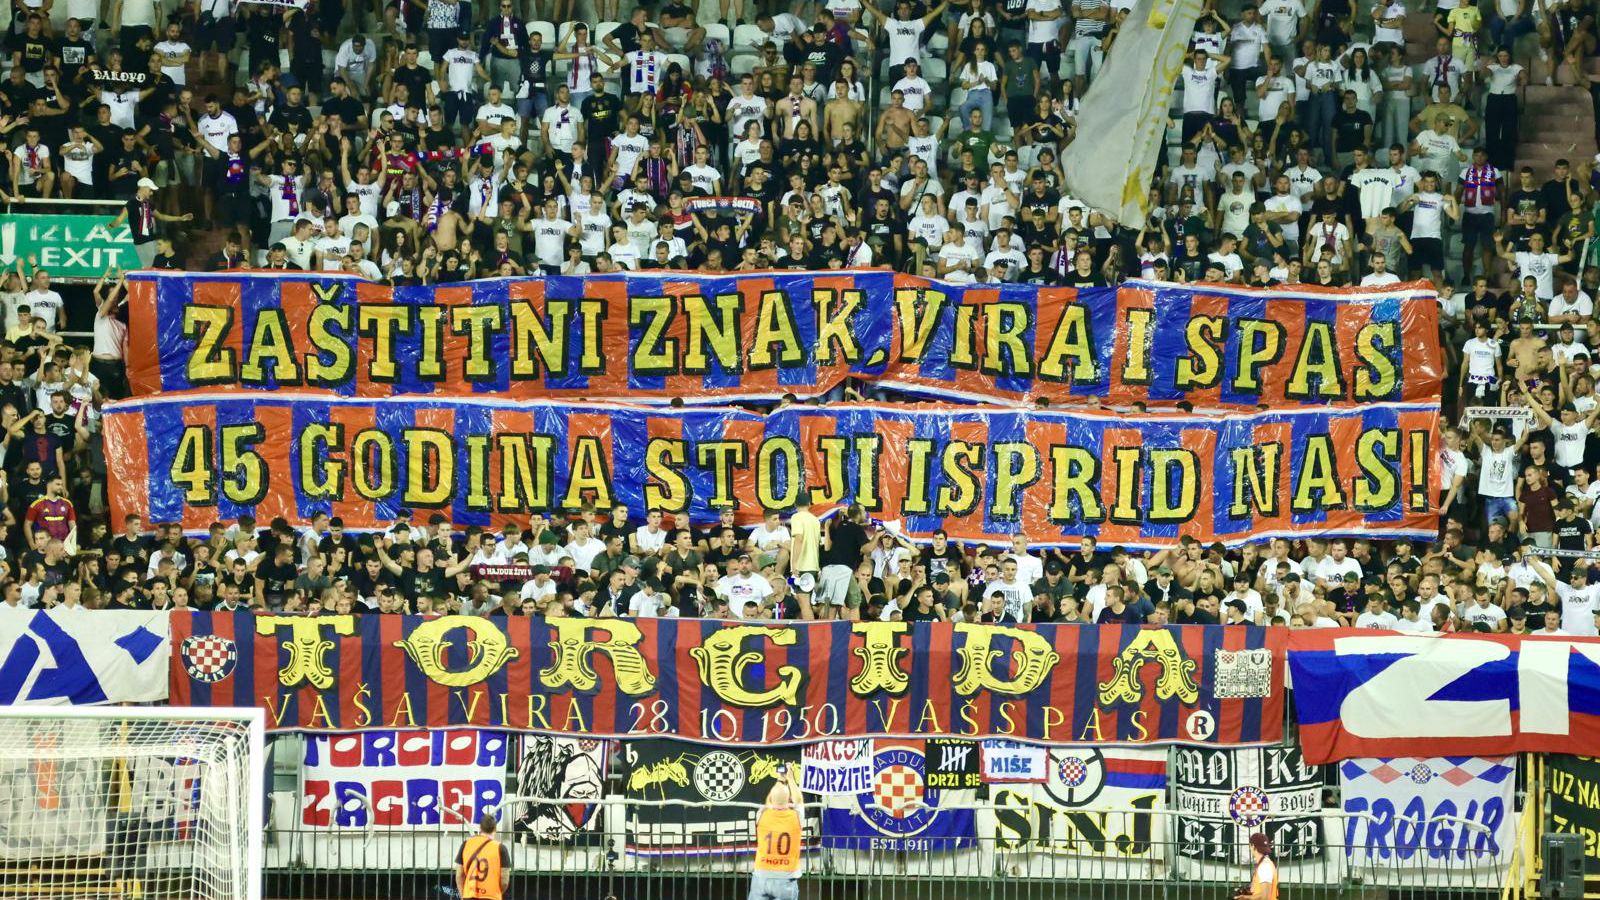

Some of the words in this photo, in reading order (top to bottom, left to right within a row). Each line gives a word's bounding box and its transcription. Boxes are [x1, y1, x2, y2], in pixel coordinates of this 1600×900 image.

[40, 247, 124, 268] EXIT
[183, 283, 608, 386] ZAŠTITNI
[894, 288, 1100, 386] VIRA
[1121, 308, 1155, 386] I
[1175, 314, 1397, 399] SPAS
[169, 422, 269, 507] 45
[299, 423, 614, 513] GODINA
[643, 432, 883, 515] STOJI
[902, 439, 1200, 526] ISPRID
[1228, 428, 1429, 519] NAS!
[255, 614, 1199, 707] TORCIDA
[263, 682, 424, 730] VAŠA
[454, 690, 588, 732] VIRA
[627, 700, 676, 737] 28.
[700, 707, 740, 742] 10.
[761, 703, 841, 743] 1950.
[872, 699, 980, 738] VAŠ
[996, 702, 1149, 742] SPAS
[304, 730, 507, 767] TORCIDA
[702, 753, 739, 769] HAJDUK
[803, 764, 872, 793] IZDRŽITE
[991, 754, 1032, 774] MIŠE
[703, 787, 734, 800] SPLIT
[928, 772, 959, 787] DRŽI
[965, 773, 981, 787] SE
[1552, 768, 1575, 802] UZ
[303, 778, 503, 827] ZAGREB
[1181, 792, 1222, 814] WHITE
[1279, 792, 1316, 813] BOYS
[870, 811, 924, 833] SPLIT
[994, 790, 1158, 854] SINJ
[1344, 795, 1505, 861] TROGIR
[764, 831, 792, 856] 10
[871, 838, 899, 851] EST.
[904, 838, 929, 851] 1911
